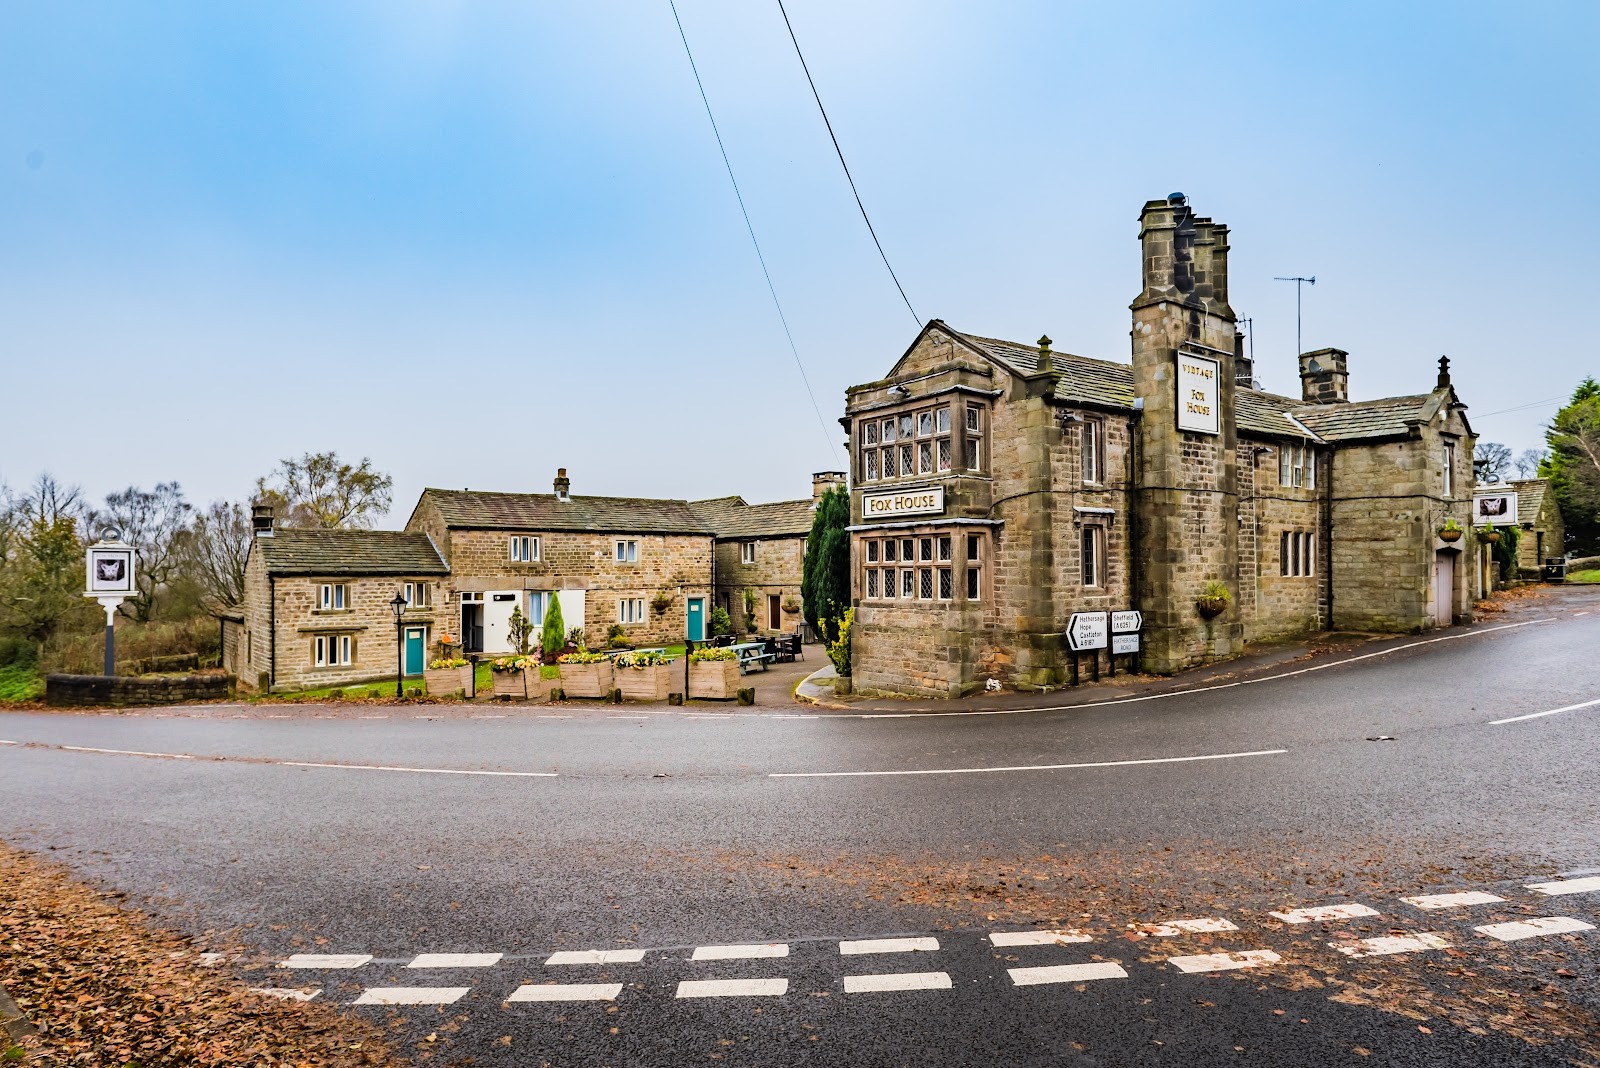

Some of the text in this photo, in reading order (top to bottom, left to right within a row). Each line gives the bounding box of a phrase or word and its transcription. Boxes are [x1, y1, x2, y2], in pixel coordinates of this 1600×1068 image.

[1191, 389, 1205, 401] FOX
[1186, 402, 1210, 415] HOUSE
[870, 495, 935, 511] FOX HOUSE
[1113, 614, 1134, 622] Sheffield
[1080, 631, 1102, 639] Castleton
